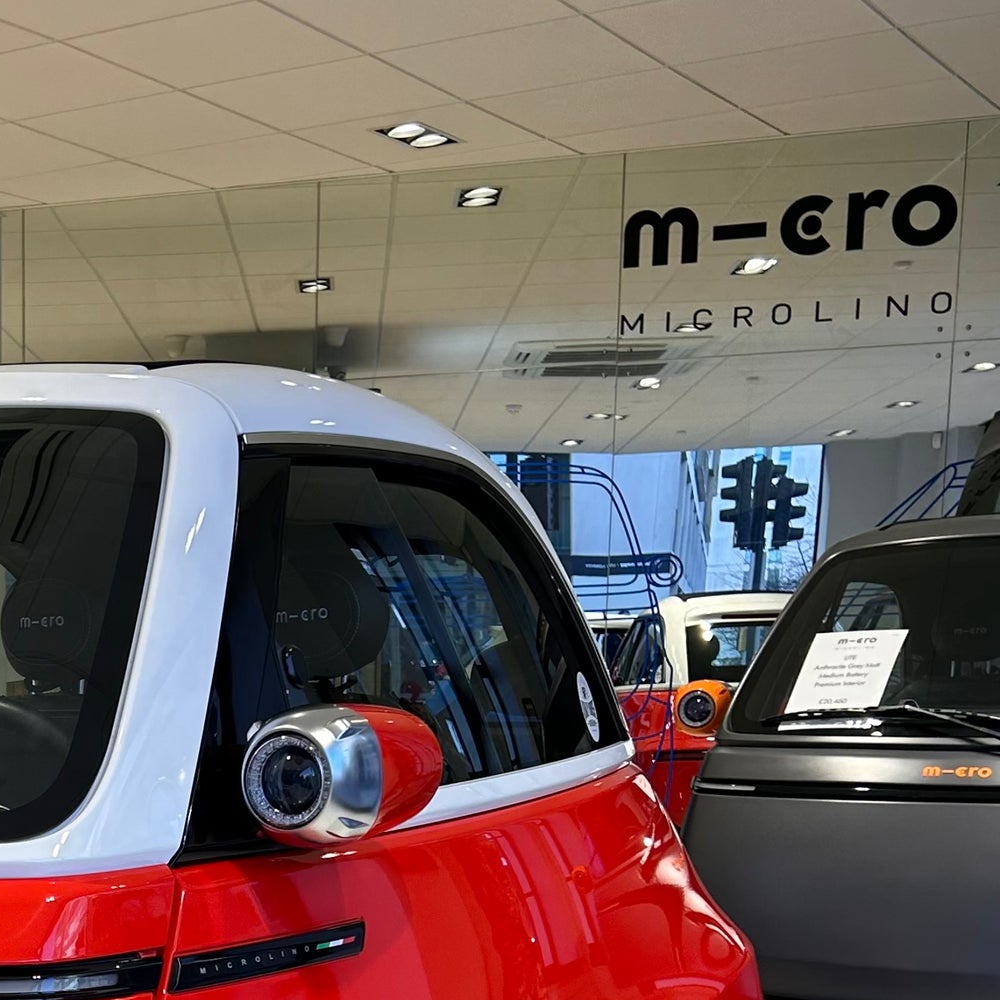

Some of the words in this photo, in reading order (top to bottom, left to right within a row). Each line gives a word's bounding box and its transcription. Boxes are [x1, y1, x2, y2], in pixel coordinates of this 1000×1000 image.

[623, 184, 958, 269] m-cro
[620, 291, 953, 335] MICROLINO
[20, 615, 64, 629] m-cro
[275, 607, 328, 623] m-cro
[837, 637, 878, 645] m-cro
[922, 765, 992, 779] m-cro
[200, 945, 310, 975] MICROLINO
